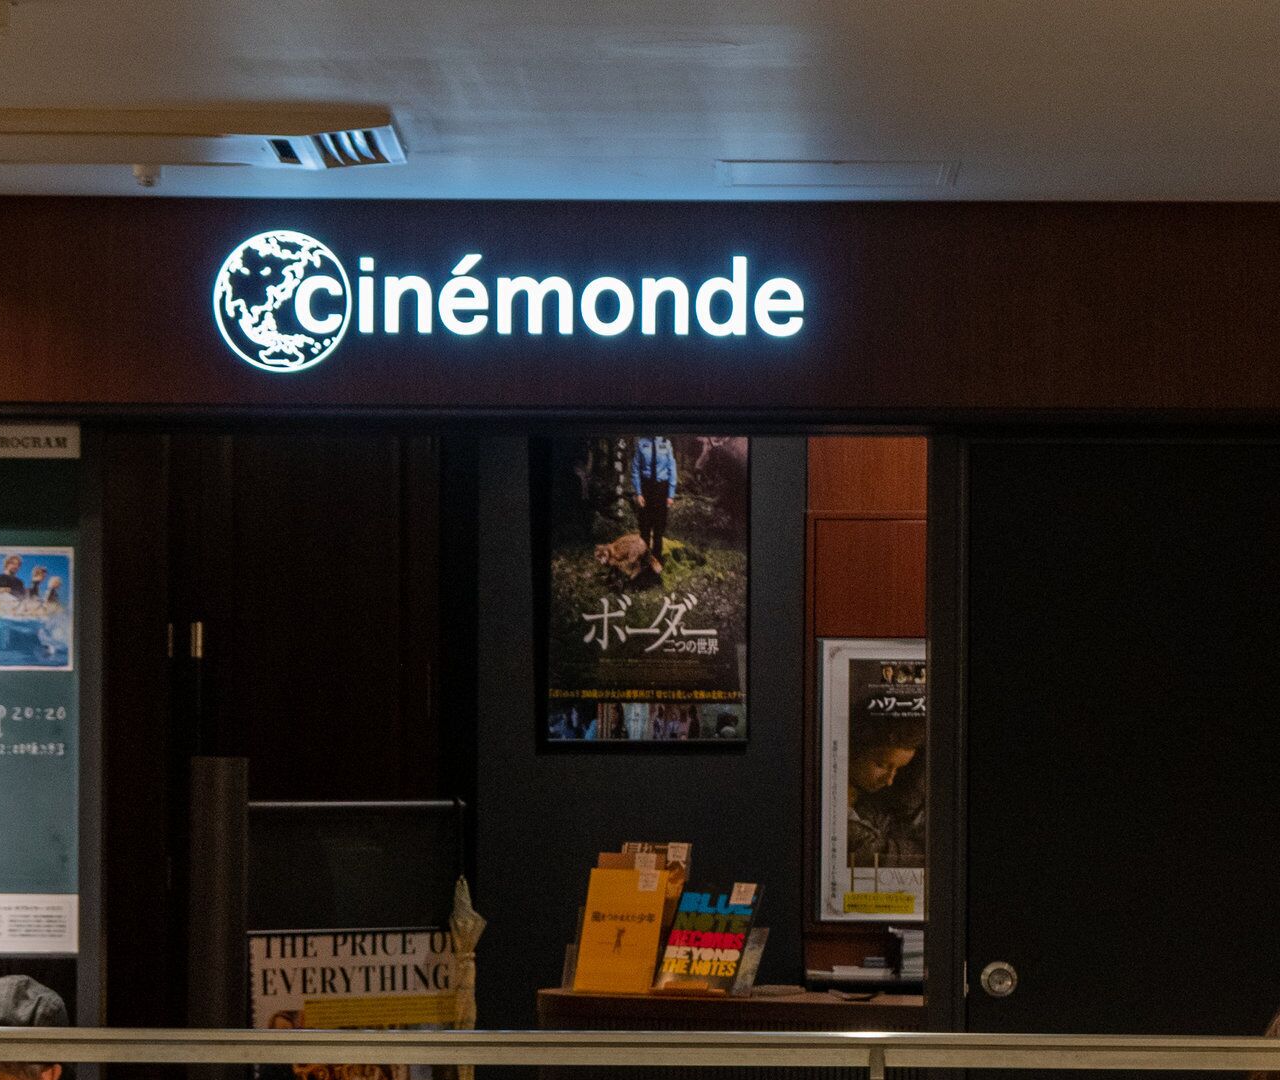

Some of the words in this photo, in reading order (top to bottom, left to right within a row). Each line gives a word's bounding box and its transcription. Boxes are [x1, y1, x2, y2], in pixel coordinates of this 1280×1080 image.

[294, 254, 805, 337] cinémonde
[582, 592, 718, 653] ボーダー
[663, 638, 719, 656] 二つの世界
[264, 934, 317, 959] THE
[331, 931, 417, 957] PRICE
[261, 962, 450, 996] EVERYTHING
